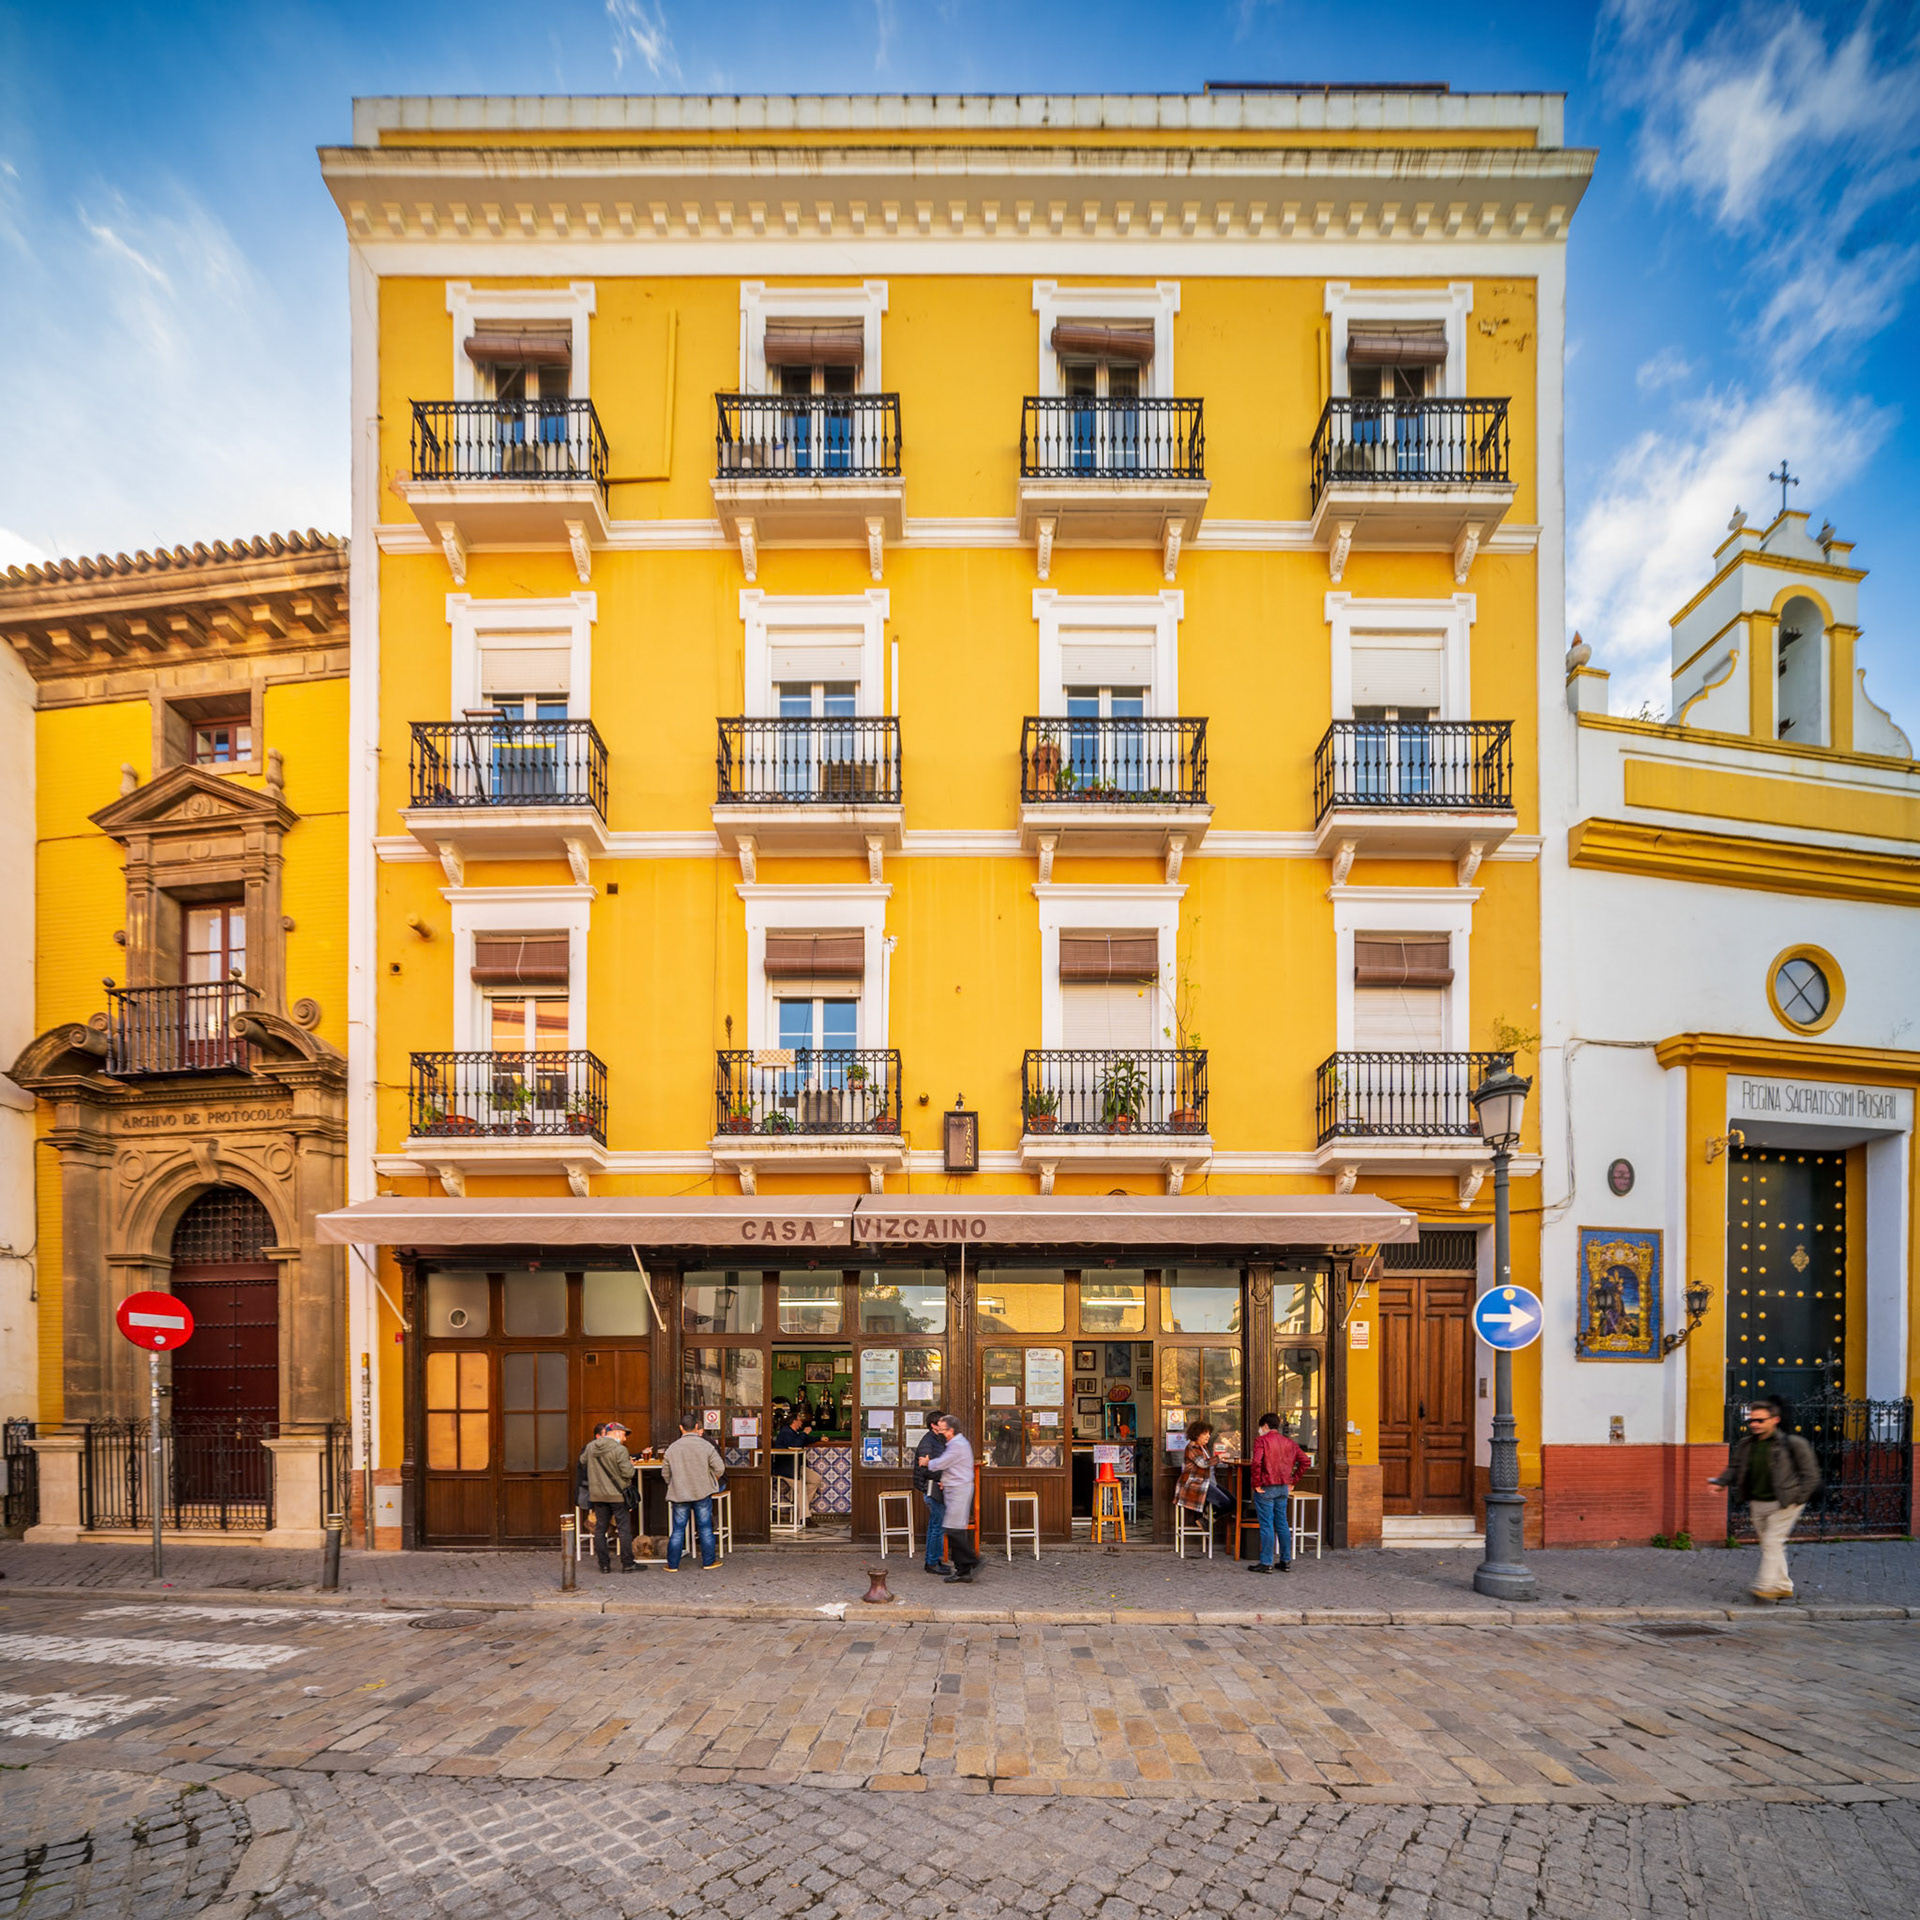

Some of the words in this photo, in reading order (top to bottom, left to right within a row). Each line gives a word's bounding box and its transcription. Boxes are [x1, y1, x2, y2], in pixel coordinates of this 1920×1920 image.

[1742, 1080, 1781, 1112] REGINA
[1785, 1085, 1854, 1117] SACRATISSIMI
[122, 1114, 177, 1128] ARCHIVO
[183, 1113, 201, 1125] DE
[207, 1108, 293, 1124] PROTOCOLOS
[741, 1221, 817, 1241] CASA
[855, 1218, 987, 1239] VIZCAINO
